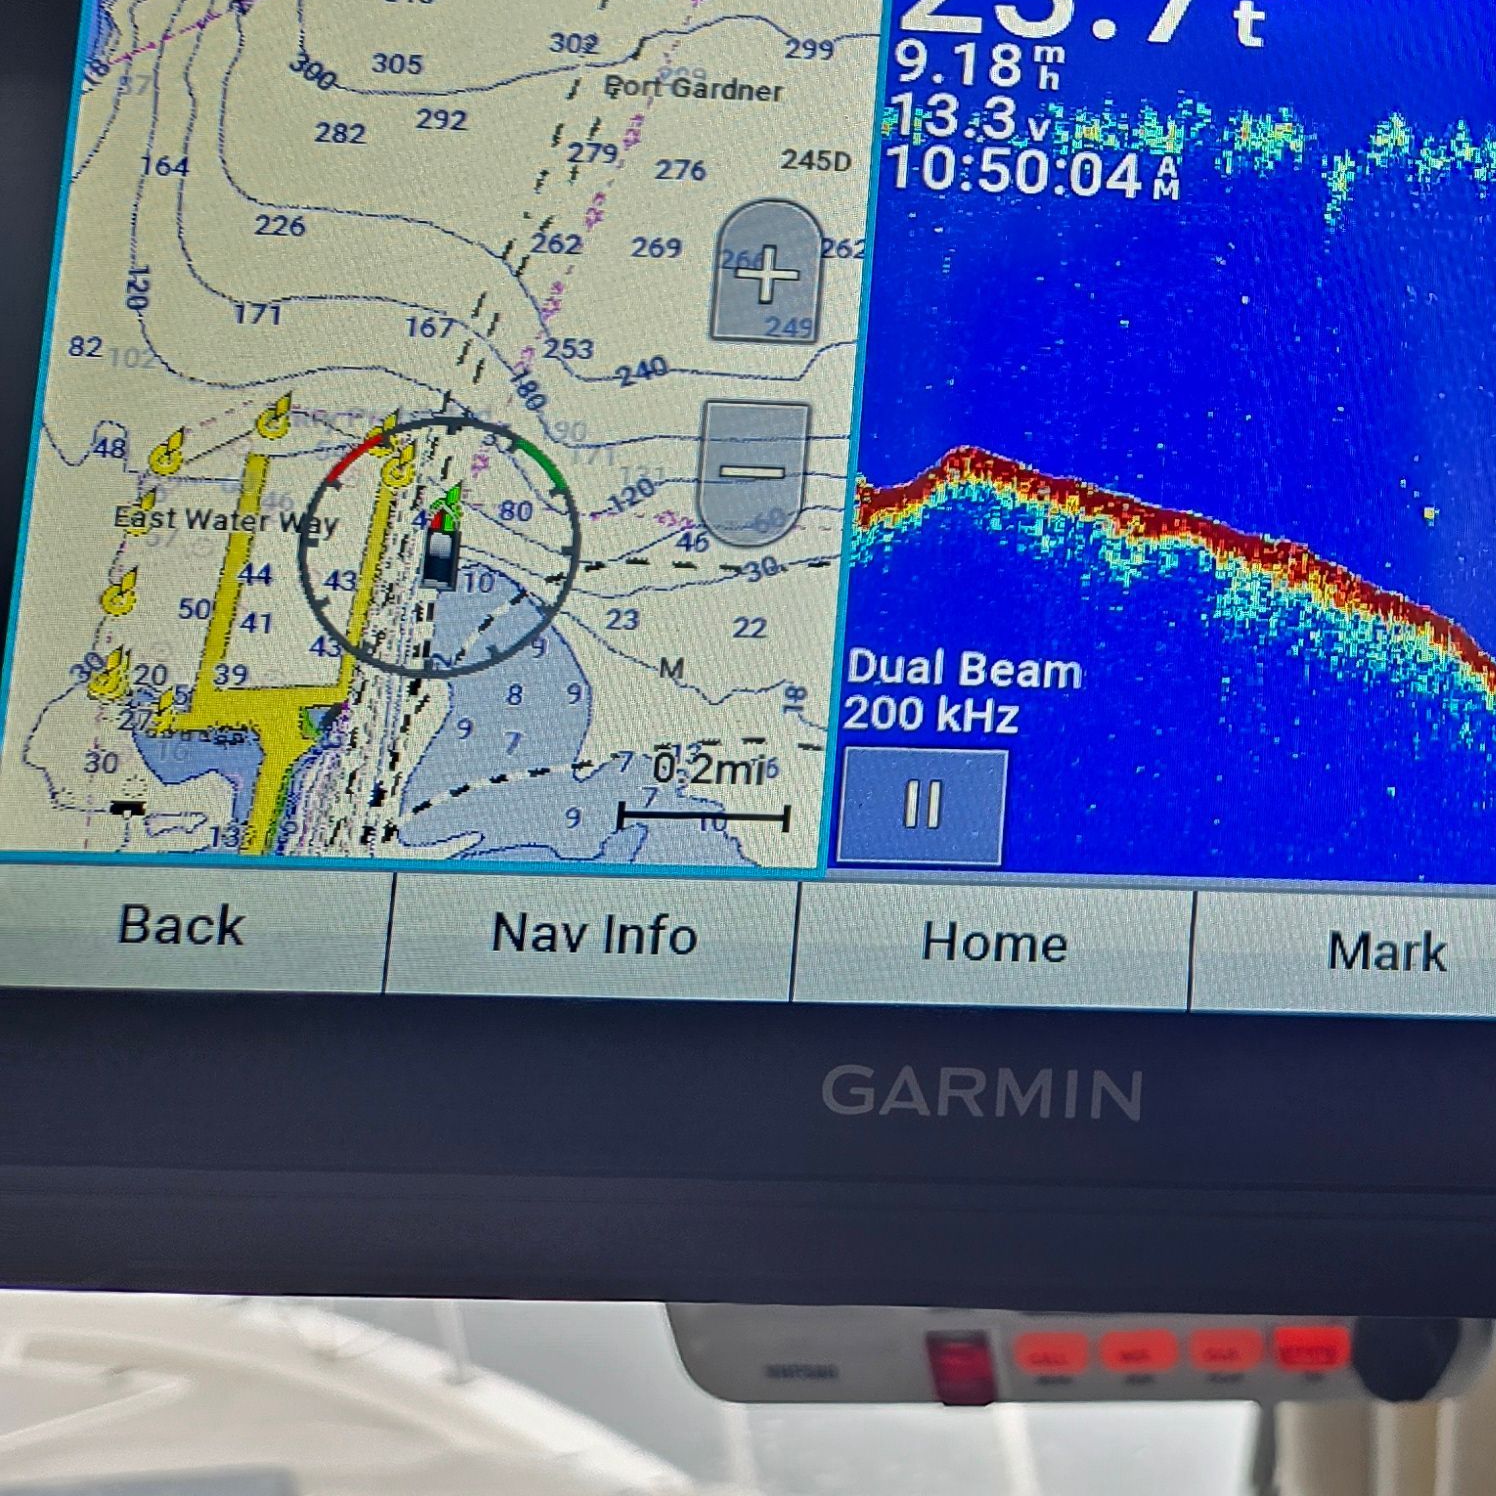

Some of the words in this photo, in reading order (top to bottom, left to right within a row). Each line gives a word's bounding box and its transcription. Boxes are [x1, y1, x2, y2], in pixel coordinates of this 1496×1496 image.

[548, 32, 600, 55] 302
[785, 39, 834, 60] 299
[289, 52, 338, 90] 300
[371, 53, 424, 75] 305
[895, 38, 1022, 87] 9.18
[604, 74, 664, 99] Port
[671, 77, 785, 102] Gardner
[415, 109, 469, 131] 292
[890, 91, 1015, 140] 13.3
[314, 122, 367, 145] 282
[566, 142, 619, 164] 279
[780, 148, 852, 173] 245D
[141, 155, 190, 176] 164
[655, 159, 708, 181] 276
[886, 144, 1142, 198] 10:50:04
[254, 215, 306, 236] 226
[531, 233, 583, 255] 262
[631, 237, 682, 259] 269
[126, 265, 151, 310] 120
[235, 304, 281, 326] 171
[406, 317, 454, 339] 167
[765, 316, 813, 338] 249
[68, 335, 103, 358] 82
[544, 339, 594, 359] 253
[615, 355, 669, 387] 240
[94, 438, 126, 459] 48
[608, 478, 655, 513] 120
[114, 505, 176, 529] East
[186, 507, 271, 532] Water
[279, 510, 340, 539] Way
[500, 501, 533, 522] 80
[675, 530, 710, 552] 46
[238, 562, 272, 585] 44
[323, 569, 356, 592] 43
[743, 557, 778, 582] 30
[467, 572, 494, 592] 10
[178, 599, 211, 620] 50
[606, 609, 640, 630] 23
[240, 613, 272, 634] 41
[733, 617, 767, 638] 22
[309, 635, 341, 657] 43
[133, 663, 167, 686] 20
[213, 663, 248, 685] 39
[659, 658, 684, 679] M
[848, 647, 945, 685] Dual
[959, 650, 1083, 689] Beam
[507, 684, 523, 705] 8
[567, 683, 582, 705] 9
[842, 694, 924, 731] 200
[936, 694, 1020, 735] kHz
[457, 719, 473, 740] 9
[505, 733, 521, 755] 7
[84, 752, 118, 774] 30
[618, 751, 634, 772] 7
[653, 751, 765, 785] 0.2mi
[642, 787, 658, 808] 7
[565, 807, 580, 828] 9
[209, 826, 240, 847] 13
[118, 903, 247, 947] Back
[492, 911, 588, 954] Nav
[604, 913, 698, 956] Info
[922, 920, 1068, 963] Home
[1327, 929, 1448, 972] Mark
[821, 1064, 1143, 1122] GARMIN
